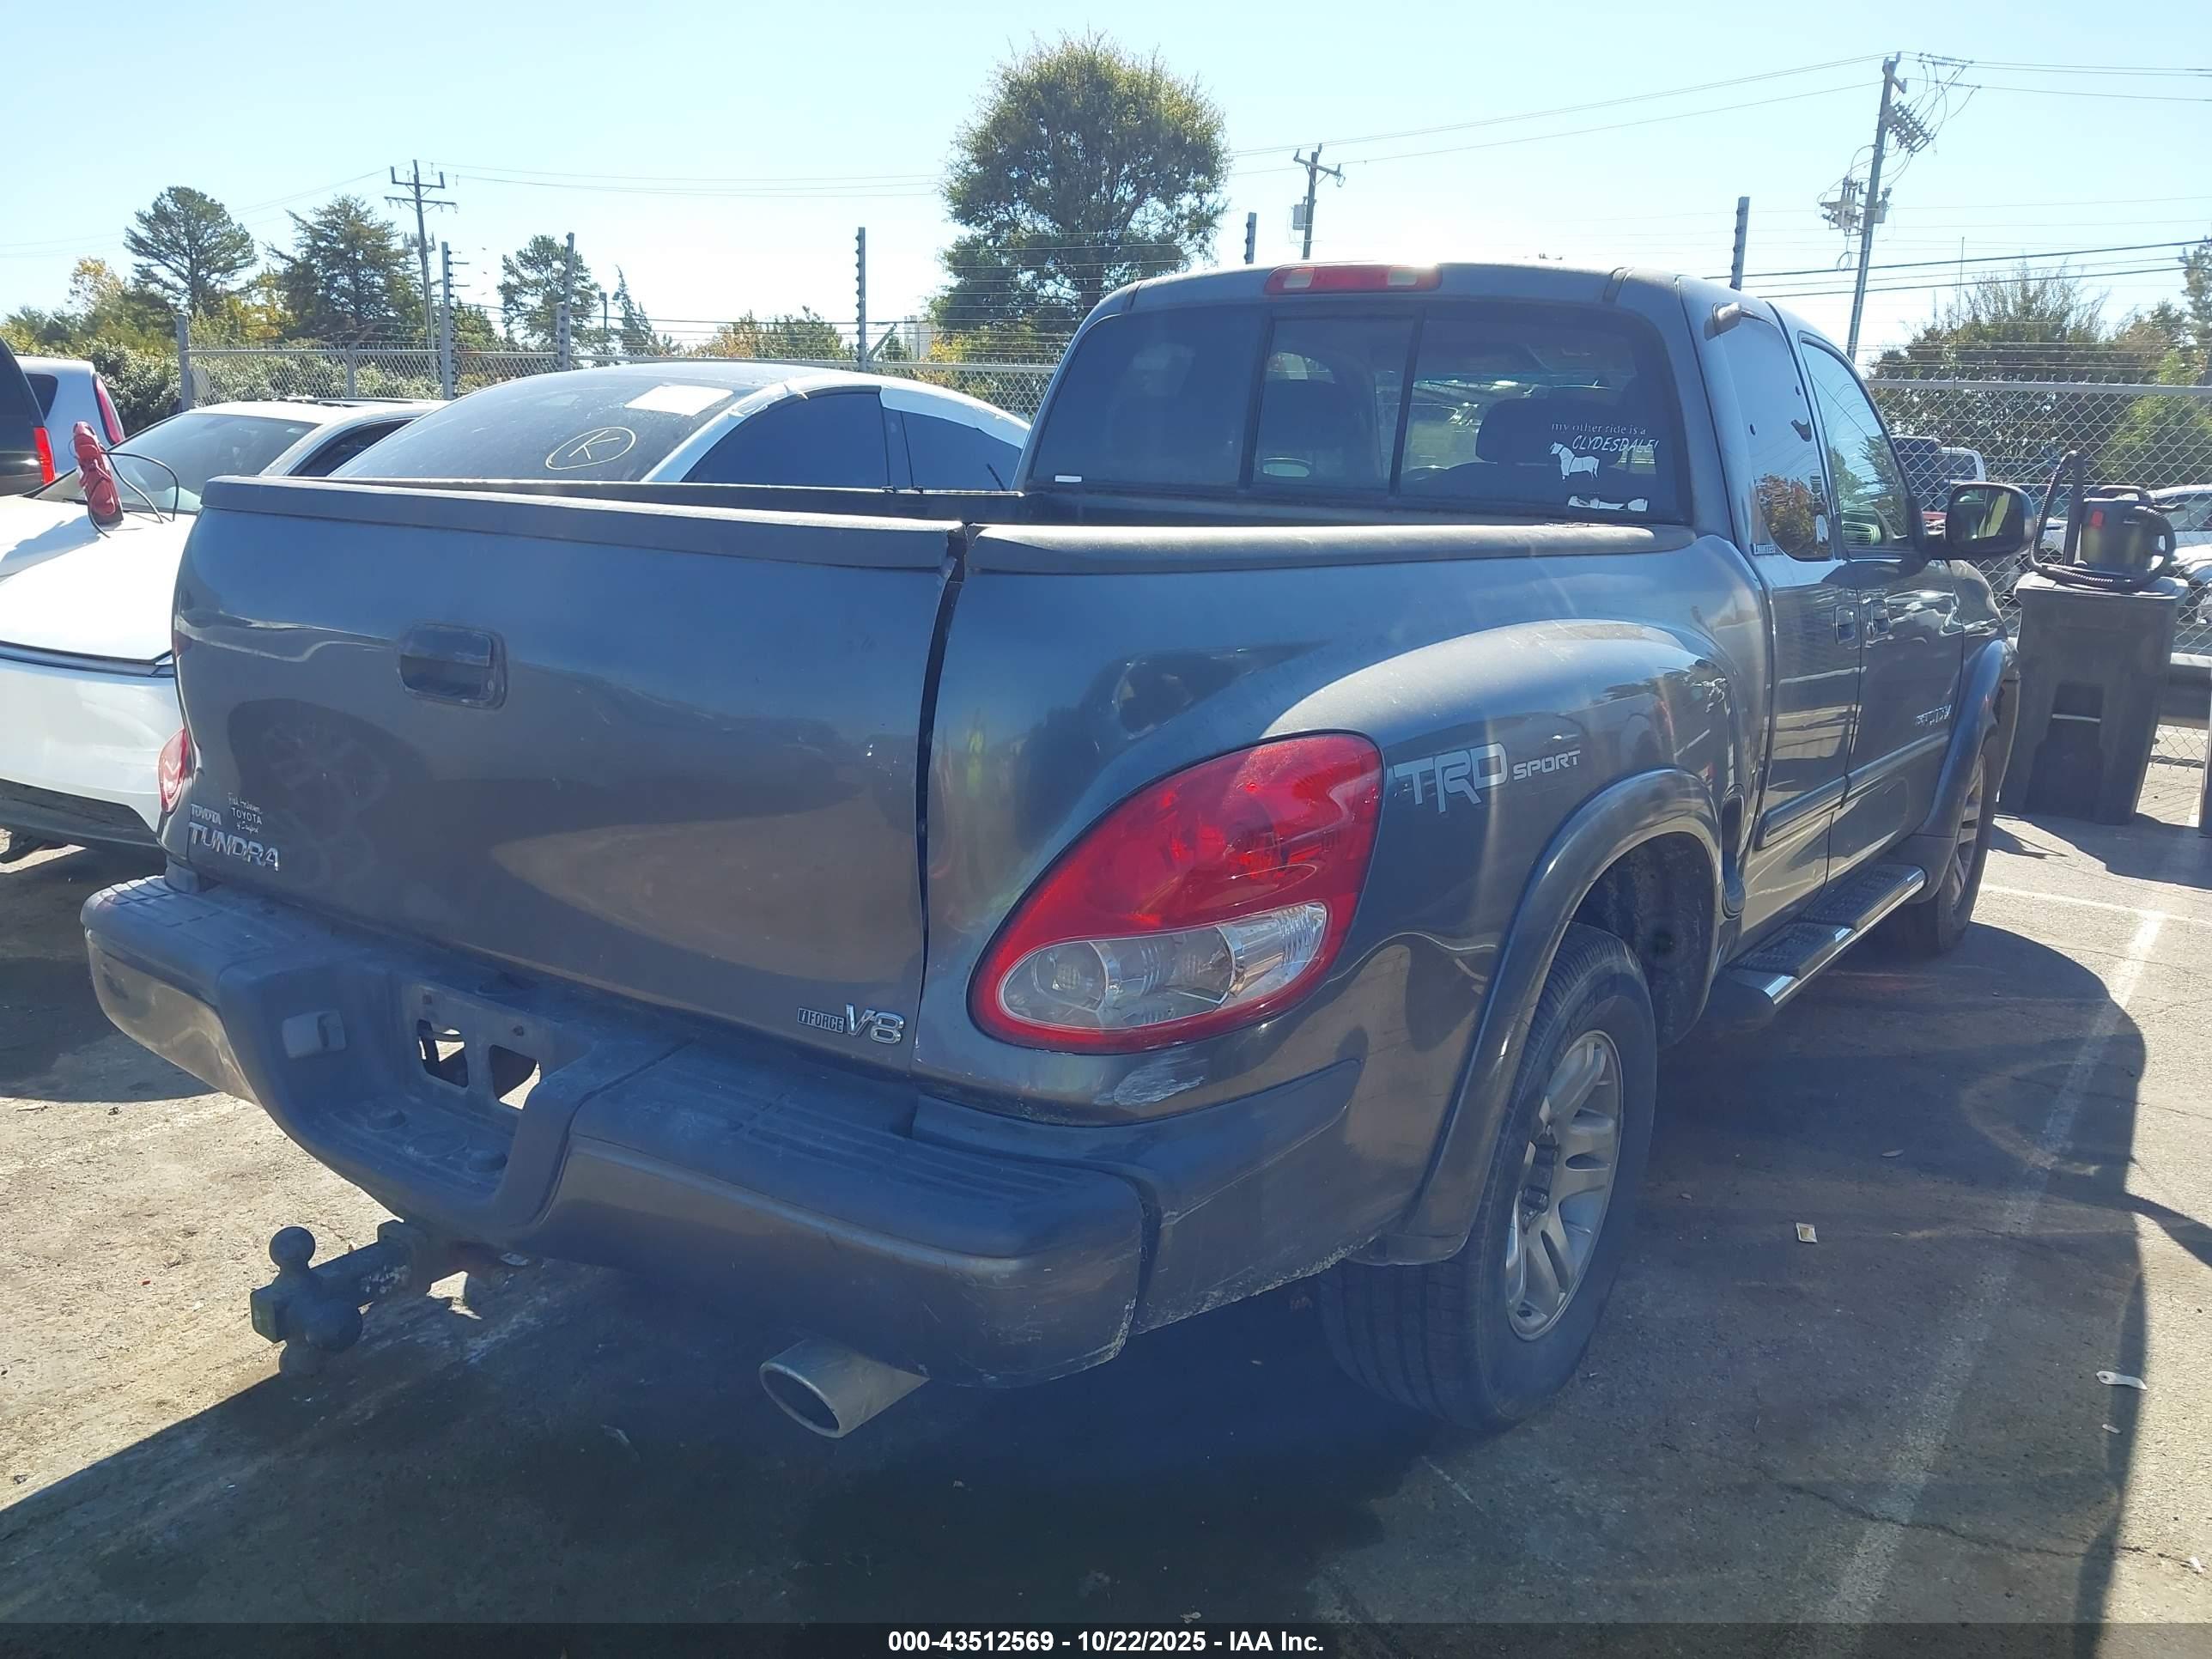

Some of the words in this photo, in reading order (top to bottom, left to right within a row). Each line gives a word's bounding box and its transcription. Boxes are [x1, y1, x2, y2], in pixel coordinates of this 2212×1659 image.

[1552, 423, 1569, 434] my
[1572, 422, 1602, 433] other
[1605, 423, 1626, 434] ride
[1629, 424, 1638, 434] is
[1393, 742, 1508, 812] TRD
[1513, 750, 1581, 782] SPORT
[191, 803, 222, 825] TOYOTA
[231, 807, 263, 825] TOYOTA
[189, 821, 279, 872] TUNDRA
[846, 1003, 905, 1044] V8
